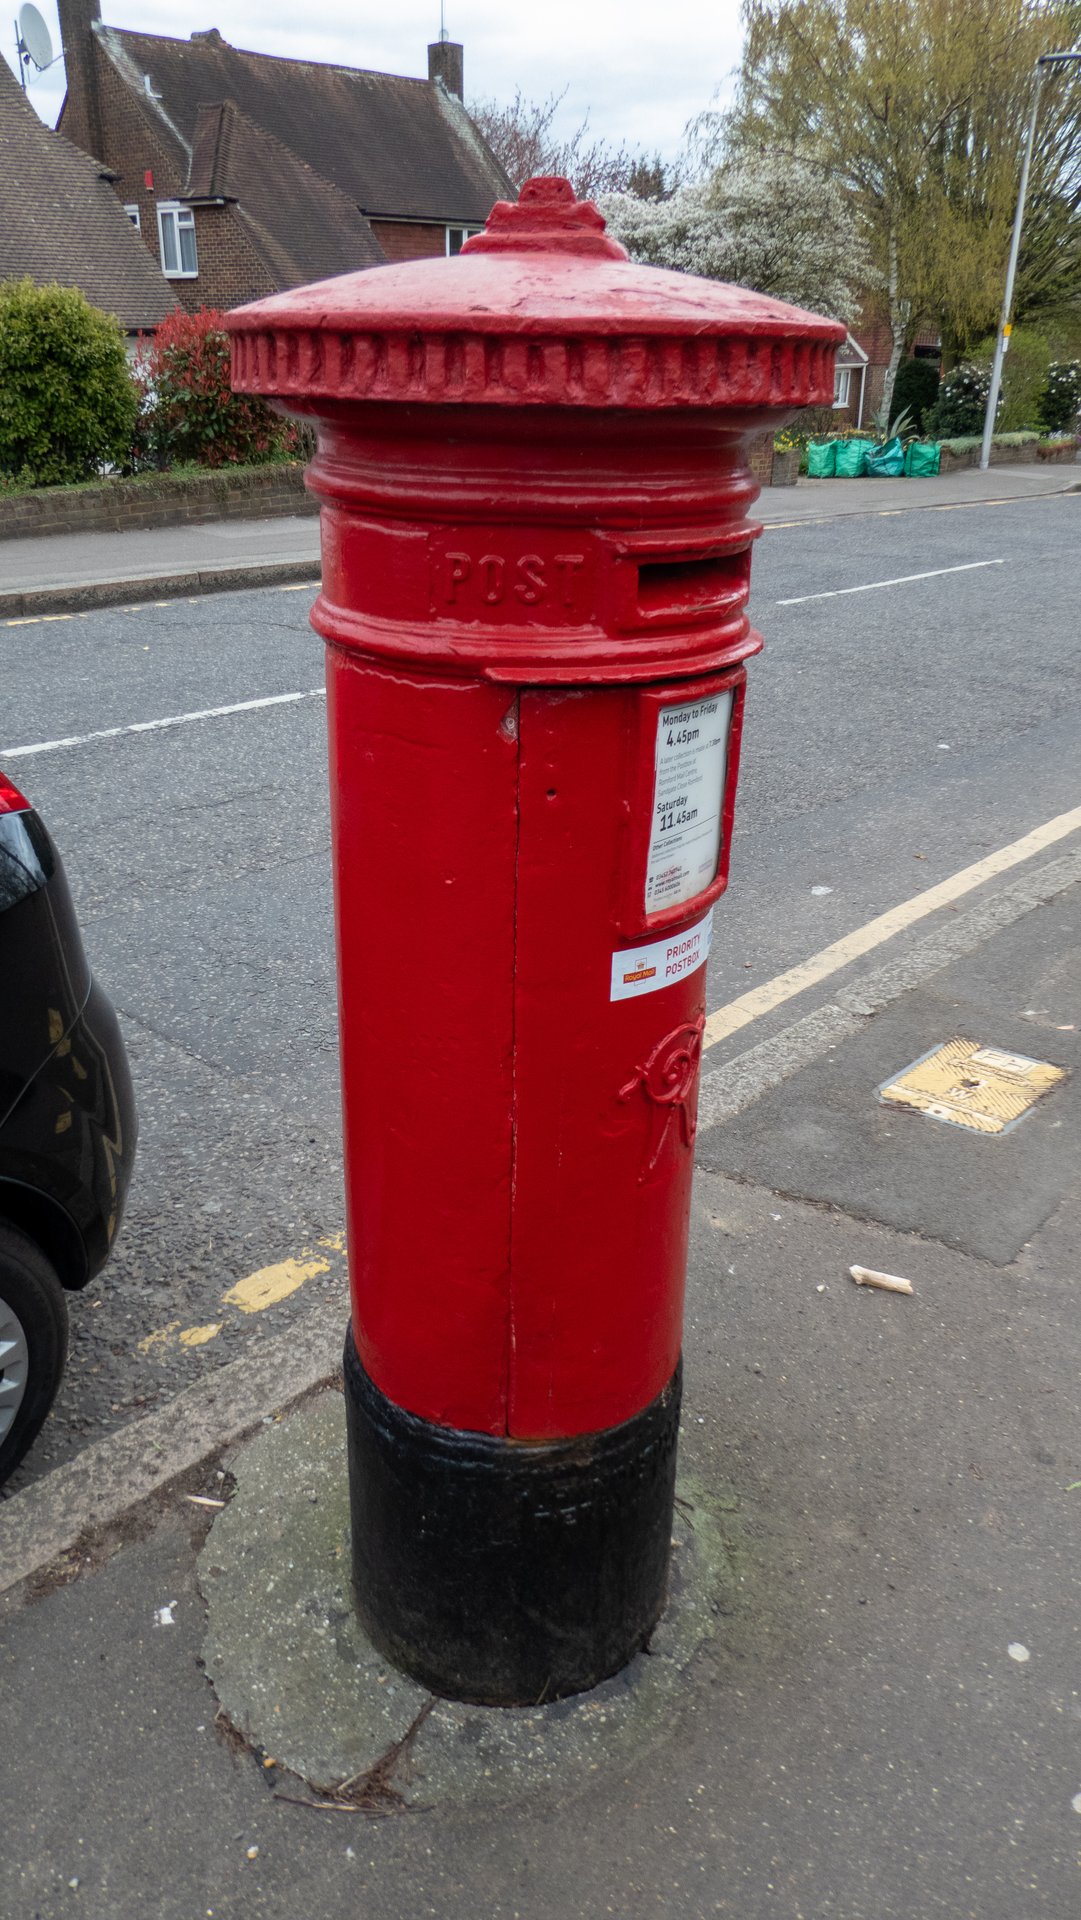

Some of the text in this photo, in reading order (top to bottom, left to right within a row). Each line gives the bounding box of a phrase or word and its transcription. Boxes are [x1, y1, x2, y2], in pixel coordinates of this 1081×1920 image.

[444, 552, 585, 607] POST
[662, 702, 718, 727] Monday to Friday
[666, 729, 700, 747] 4.45pm
[657, 796, 688, 814] Saturday
[660, 809, 698, 832] 11.45am
[666, 932, 701, 961] PRIORITY
[624, 968, 655, 982] Royal Mail
[665, 950, 700, 978] POSTBOX
